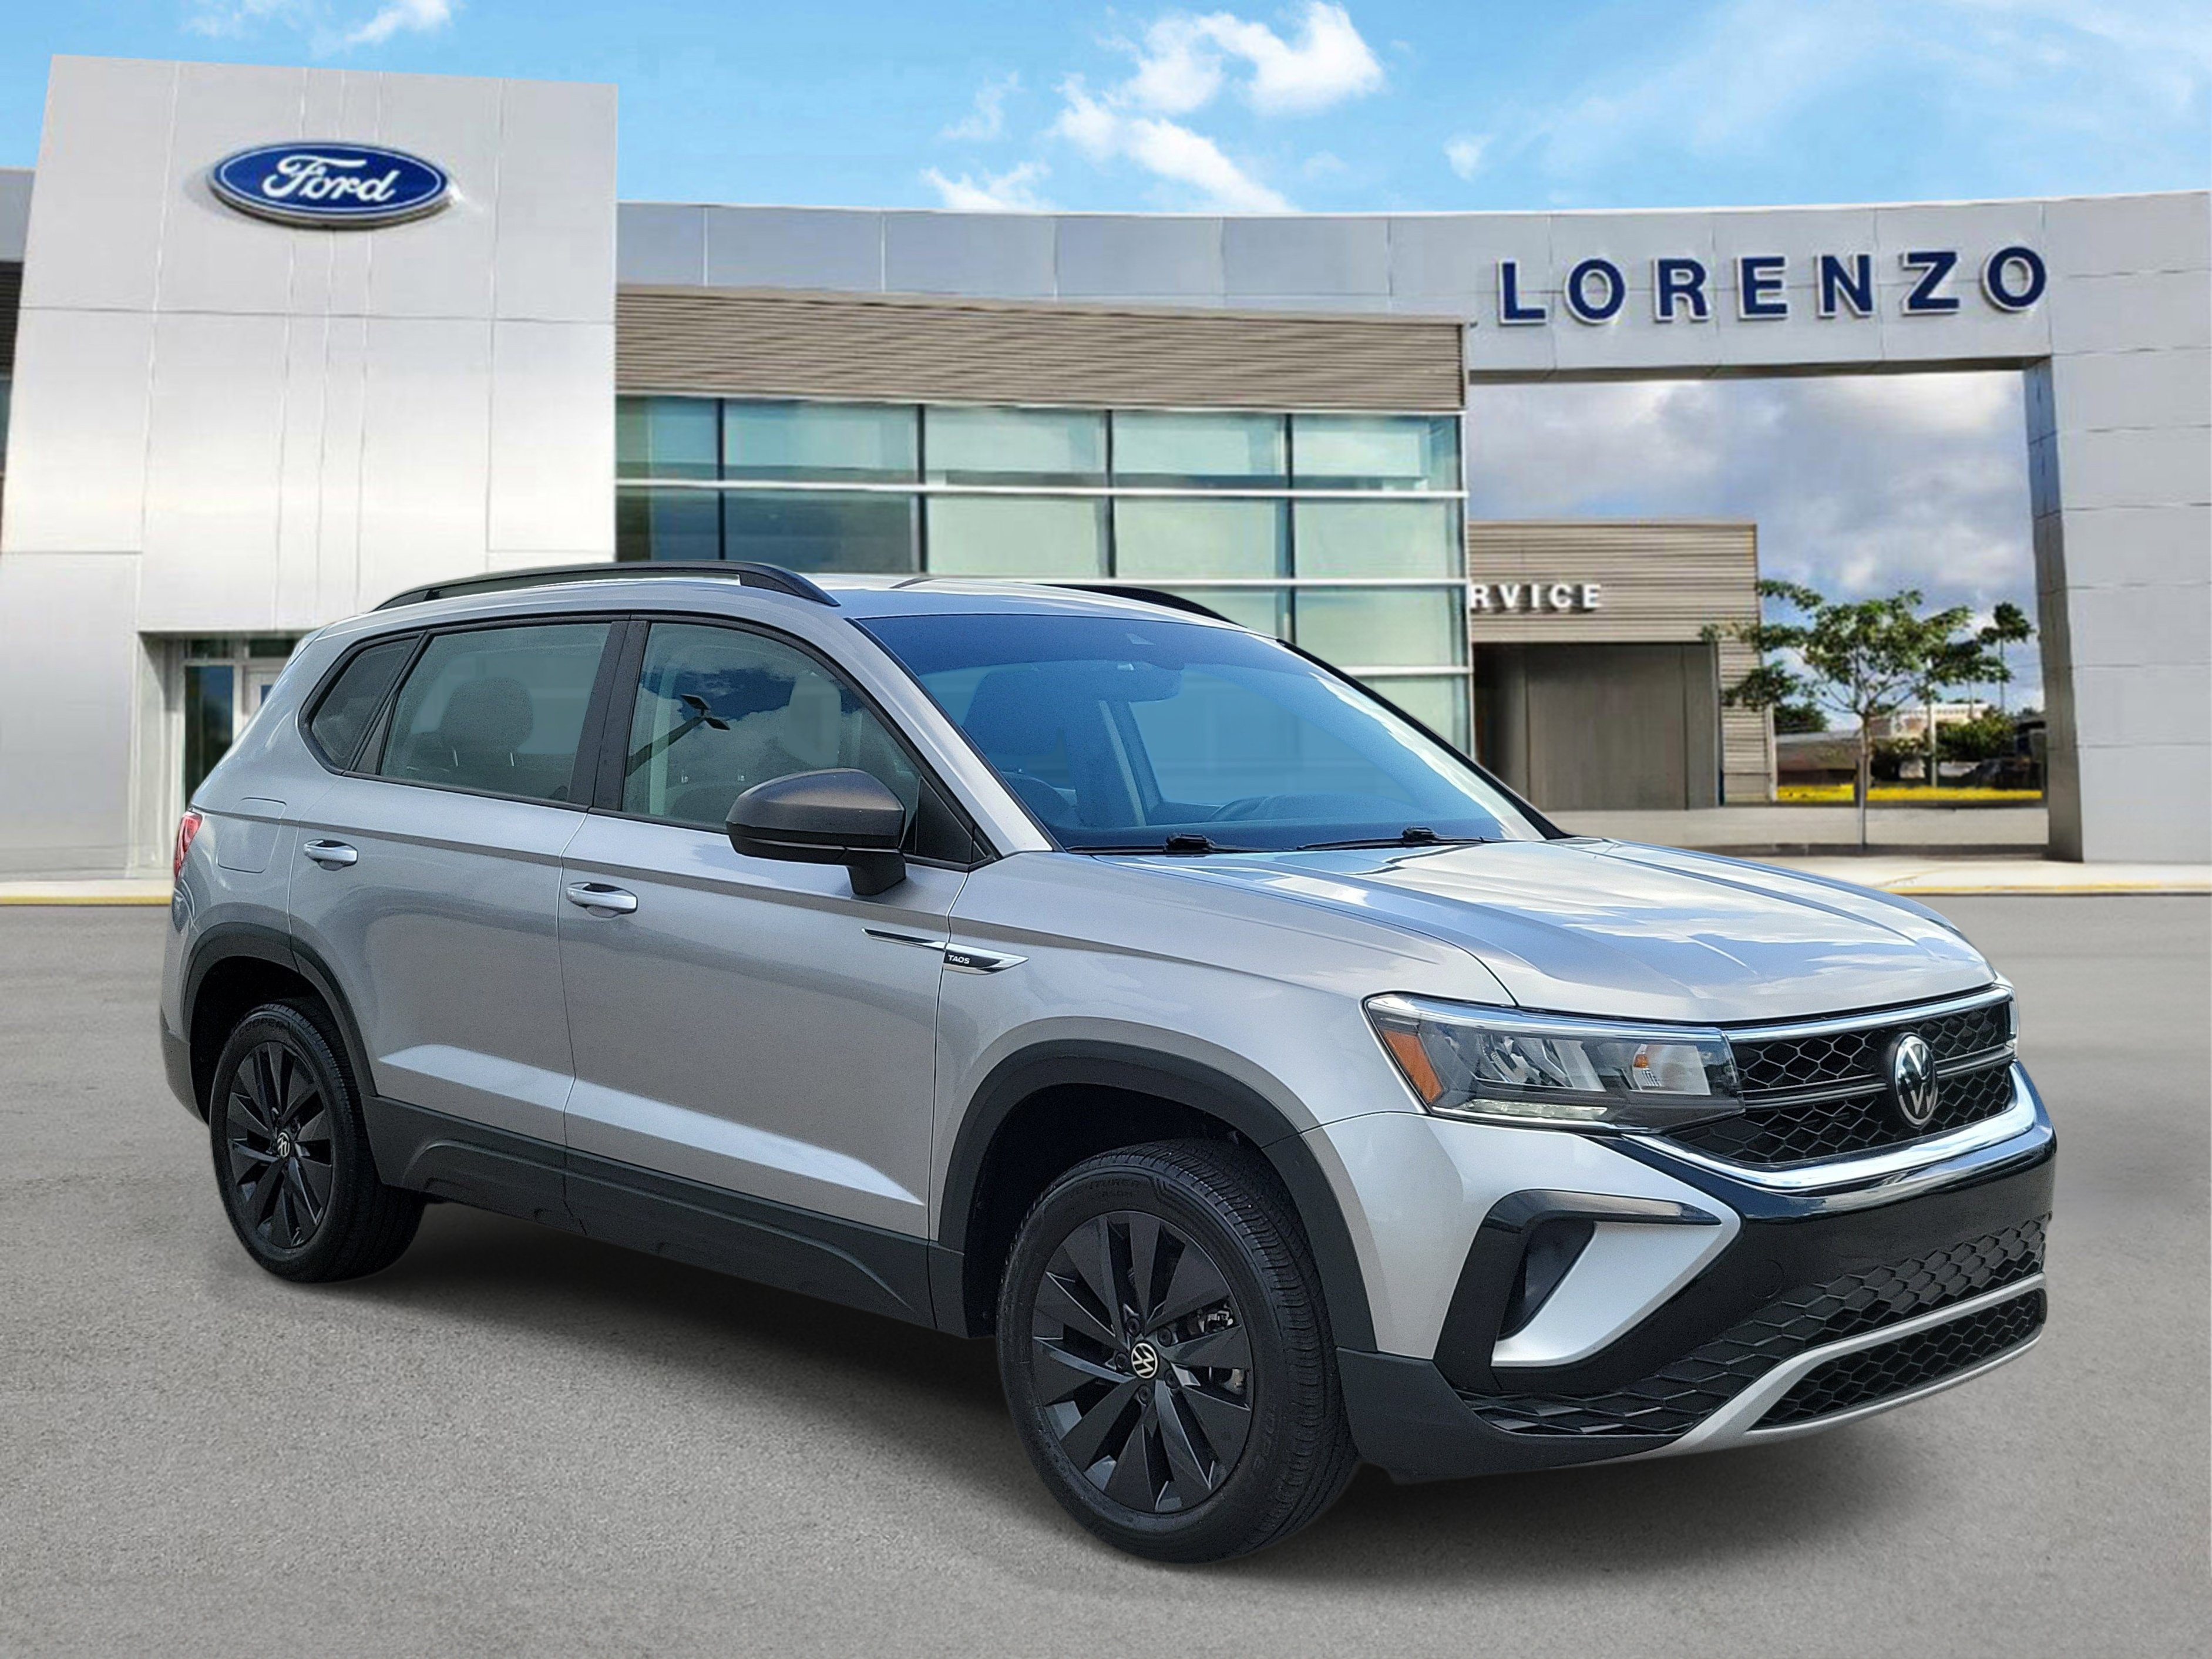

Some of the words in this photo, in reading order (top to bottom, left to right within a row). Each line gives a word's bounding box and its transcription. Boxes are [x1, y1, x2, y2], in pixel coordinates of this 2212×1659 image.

[261, 154, 401, 202] Ford
[1498, 246, 2046, 323] LORENZO
[948, 954, 970, 964] TAOS
